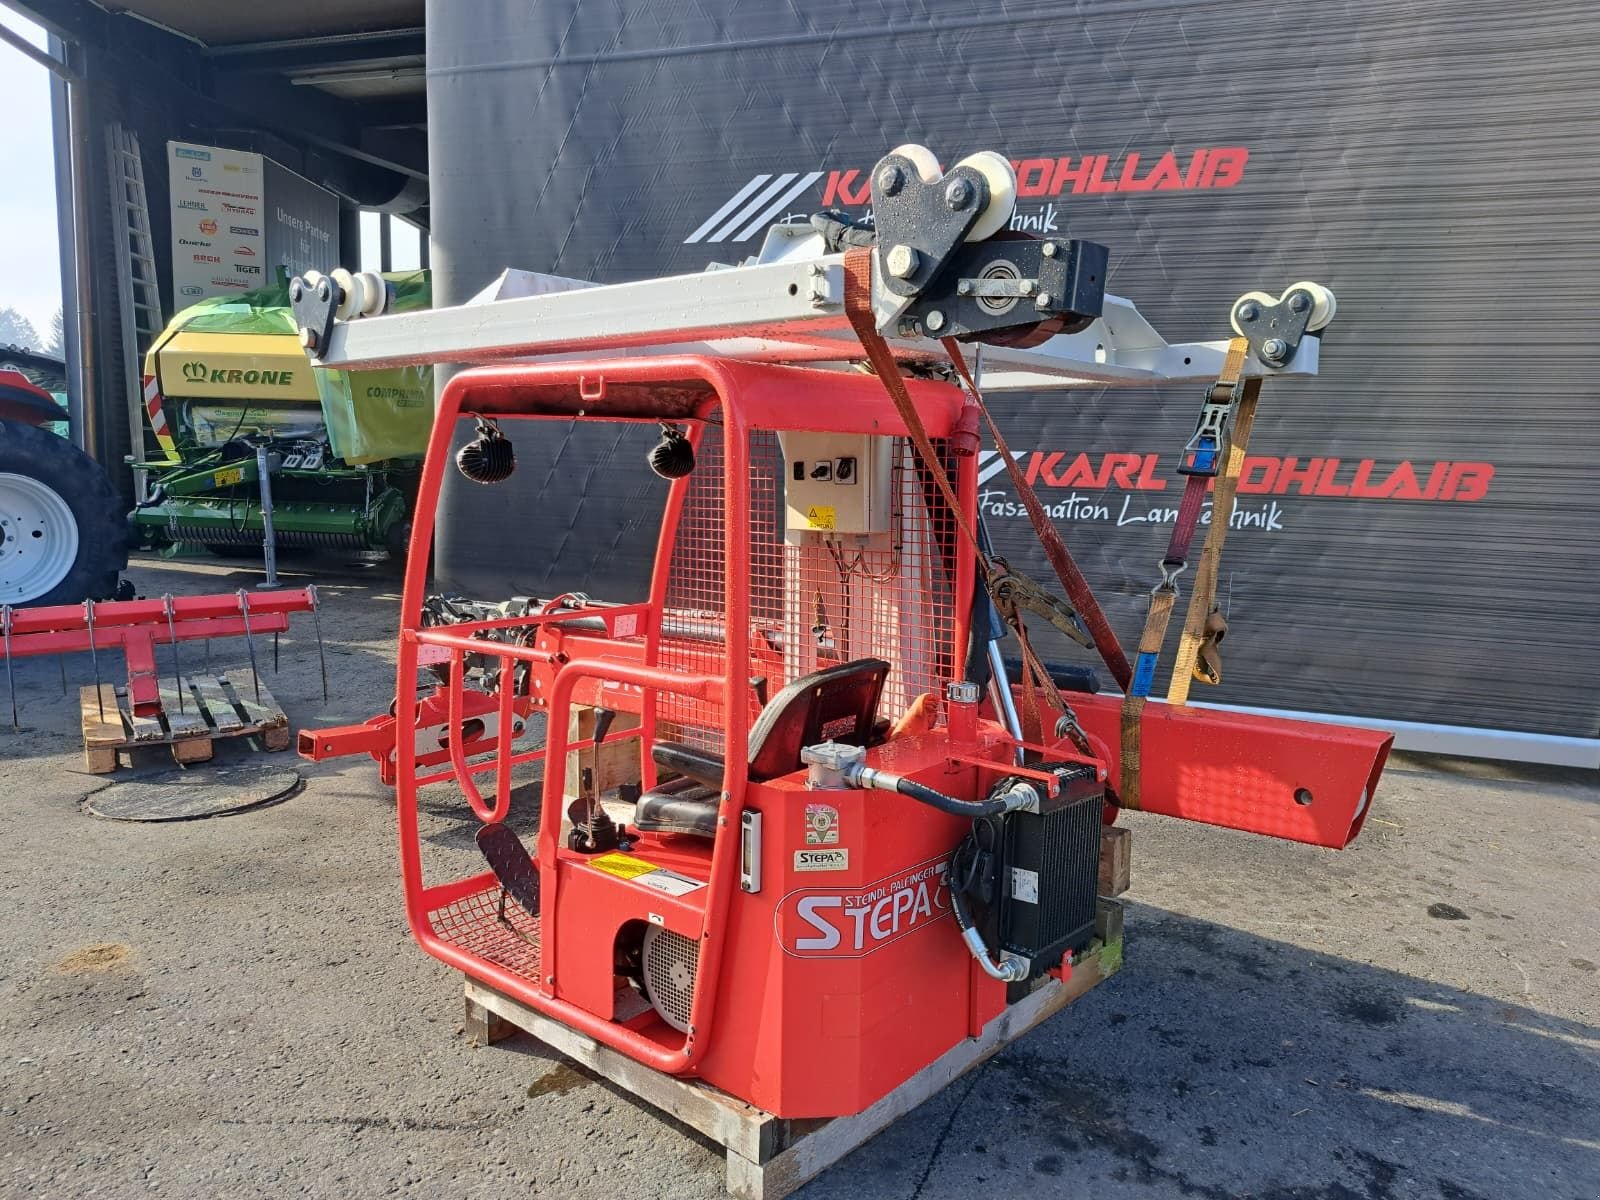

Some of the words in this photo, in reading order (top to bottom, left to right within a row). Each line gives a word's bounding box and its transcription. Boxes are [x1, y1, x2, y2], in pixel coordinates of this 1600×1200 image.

[277, 207, 303, 231] Unsere
[209, 369, 294, 386] KRONE
[1023, 451, 1168, 490] KARL
[1187, 454, 1496, 501] OHLLAIB
[978, 489, 1109, 520] Fasznation
[800, 852, 834, 863] STEPA
[796, 882, 932, 950] STEPA
